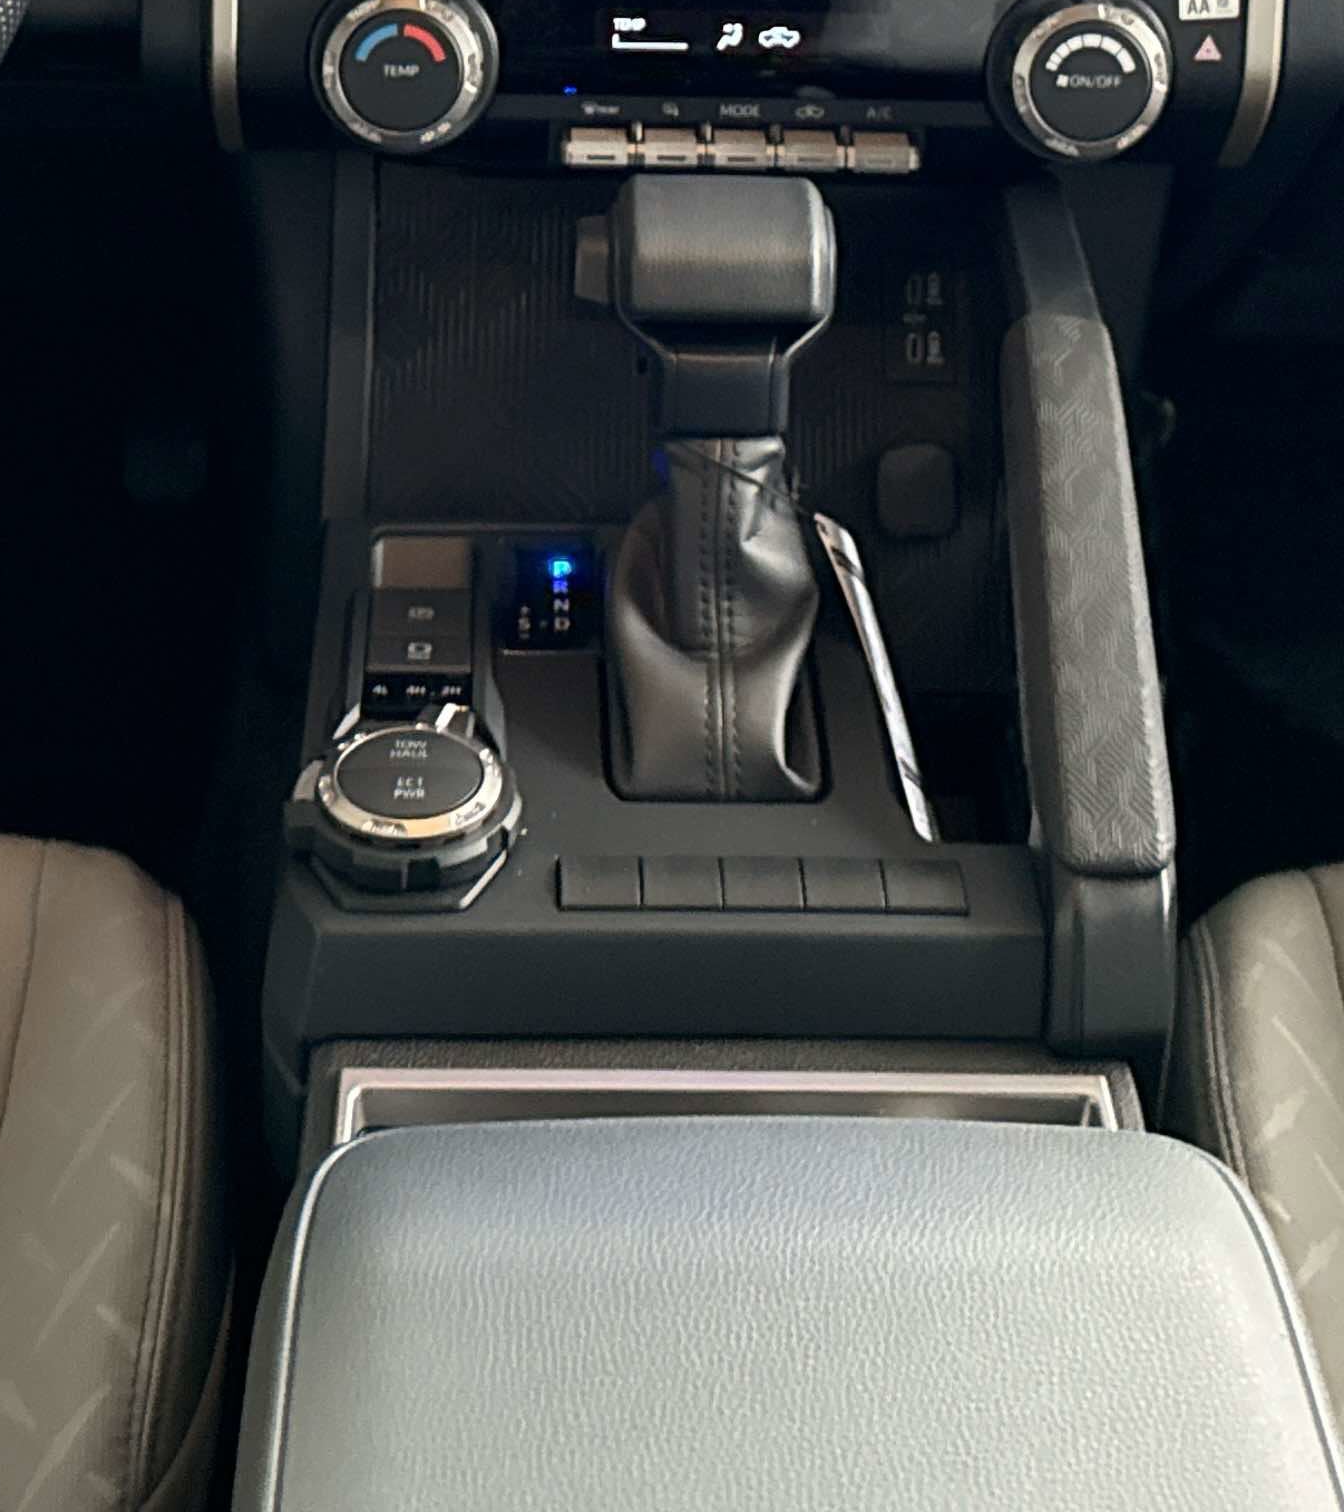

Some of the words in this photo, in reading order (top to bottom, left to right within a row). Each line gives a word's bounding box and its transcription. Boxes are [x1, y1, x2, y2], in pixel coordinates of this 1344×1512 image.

[613, 17, 646, 31] TEMP
[384, 64, 420, 78] TEMP
[1070, 75, 1122, 88] ON/OFF
[720, 103, 761, 118] MODE
[866, 104, 892, 119] A/C
[553, 560, 572, 578] P
[553, 598, 570, 613] N
[554, 616, 570, 631] D
[393, 788, 426, 799] PWR
